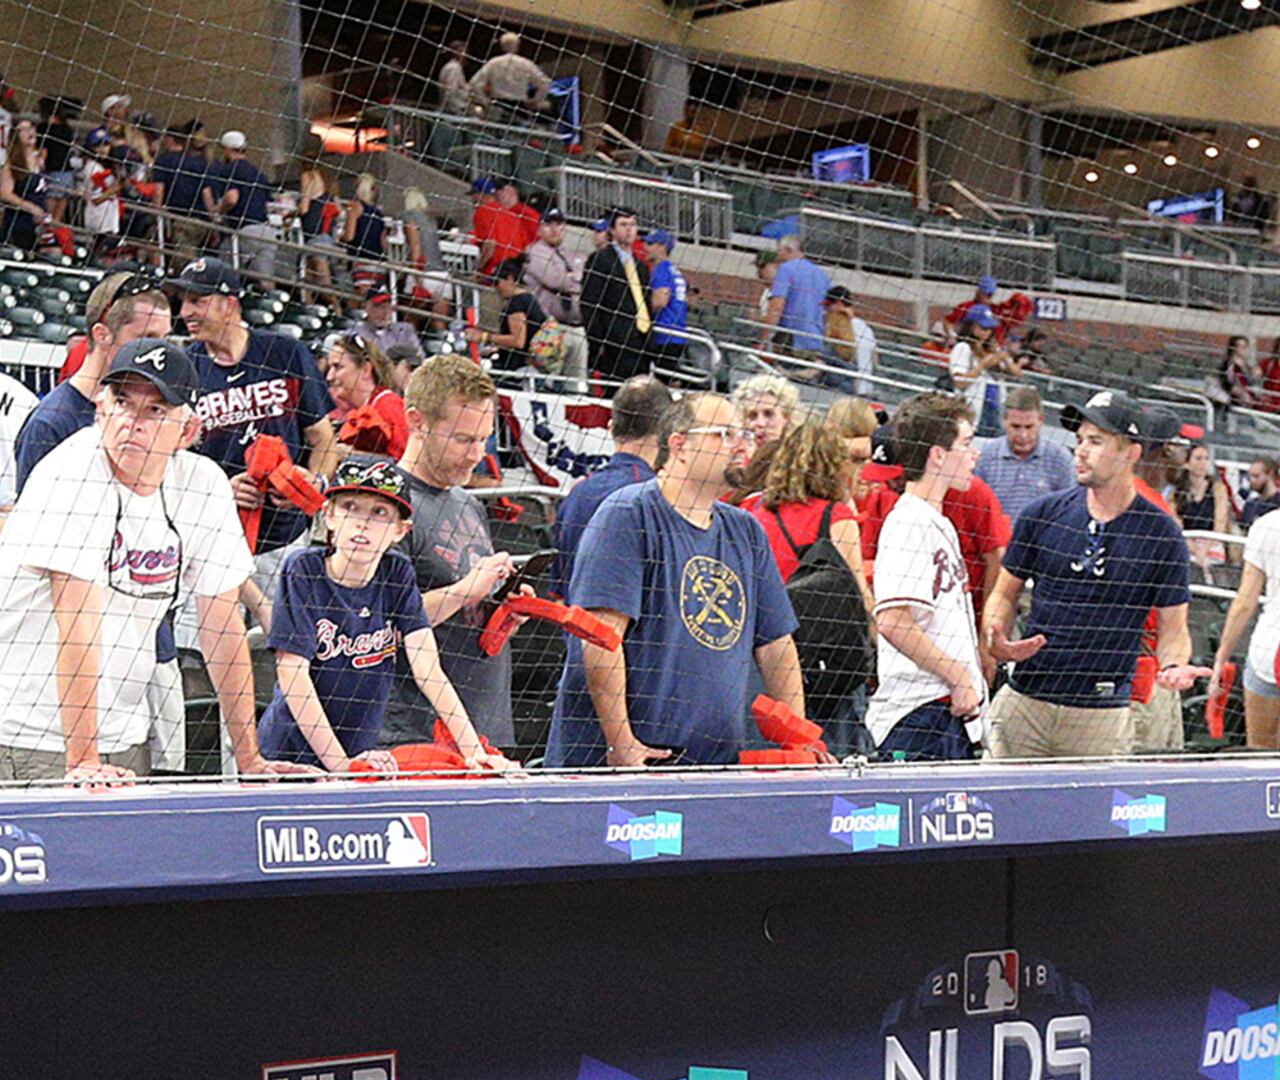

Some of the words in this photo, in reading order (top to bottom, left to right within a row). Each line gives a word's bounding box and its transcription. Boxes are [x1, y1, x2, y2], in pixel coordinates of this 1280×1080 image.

[196, 379, 289, 421] BRAVES
[830, 814, 899, 833] DOOSAN
[921, 812, 994, 843] NLDS
[1111, 804, 1166, 821] DOOSAN
[264, 827, 384, 864] MLB.com
[606, 822, 682, 842] DOOSAN
[931, 972, 959, 997] 20
[1023, 964, 1049, 987] 18
